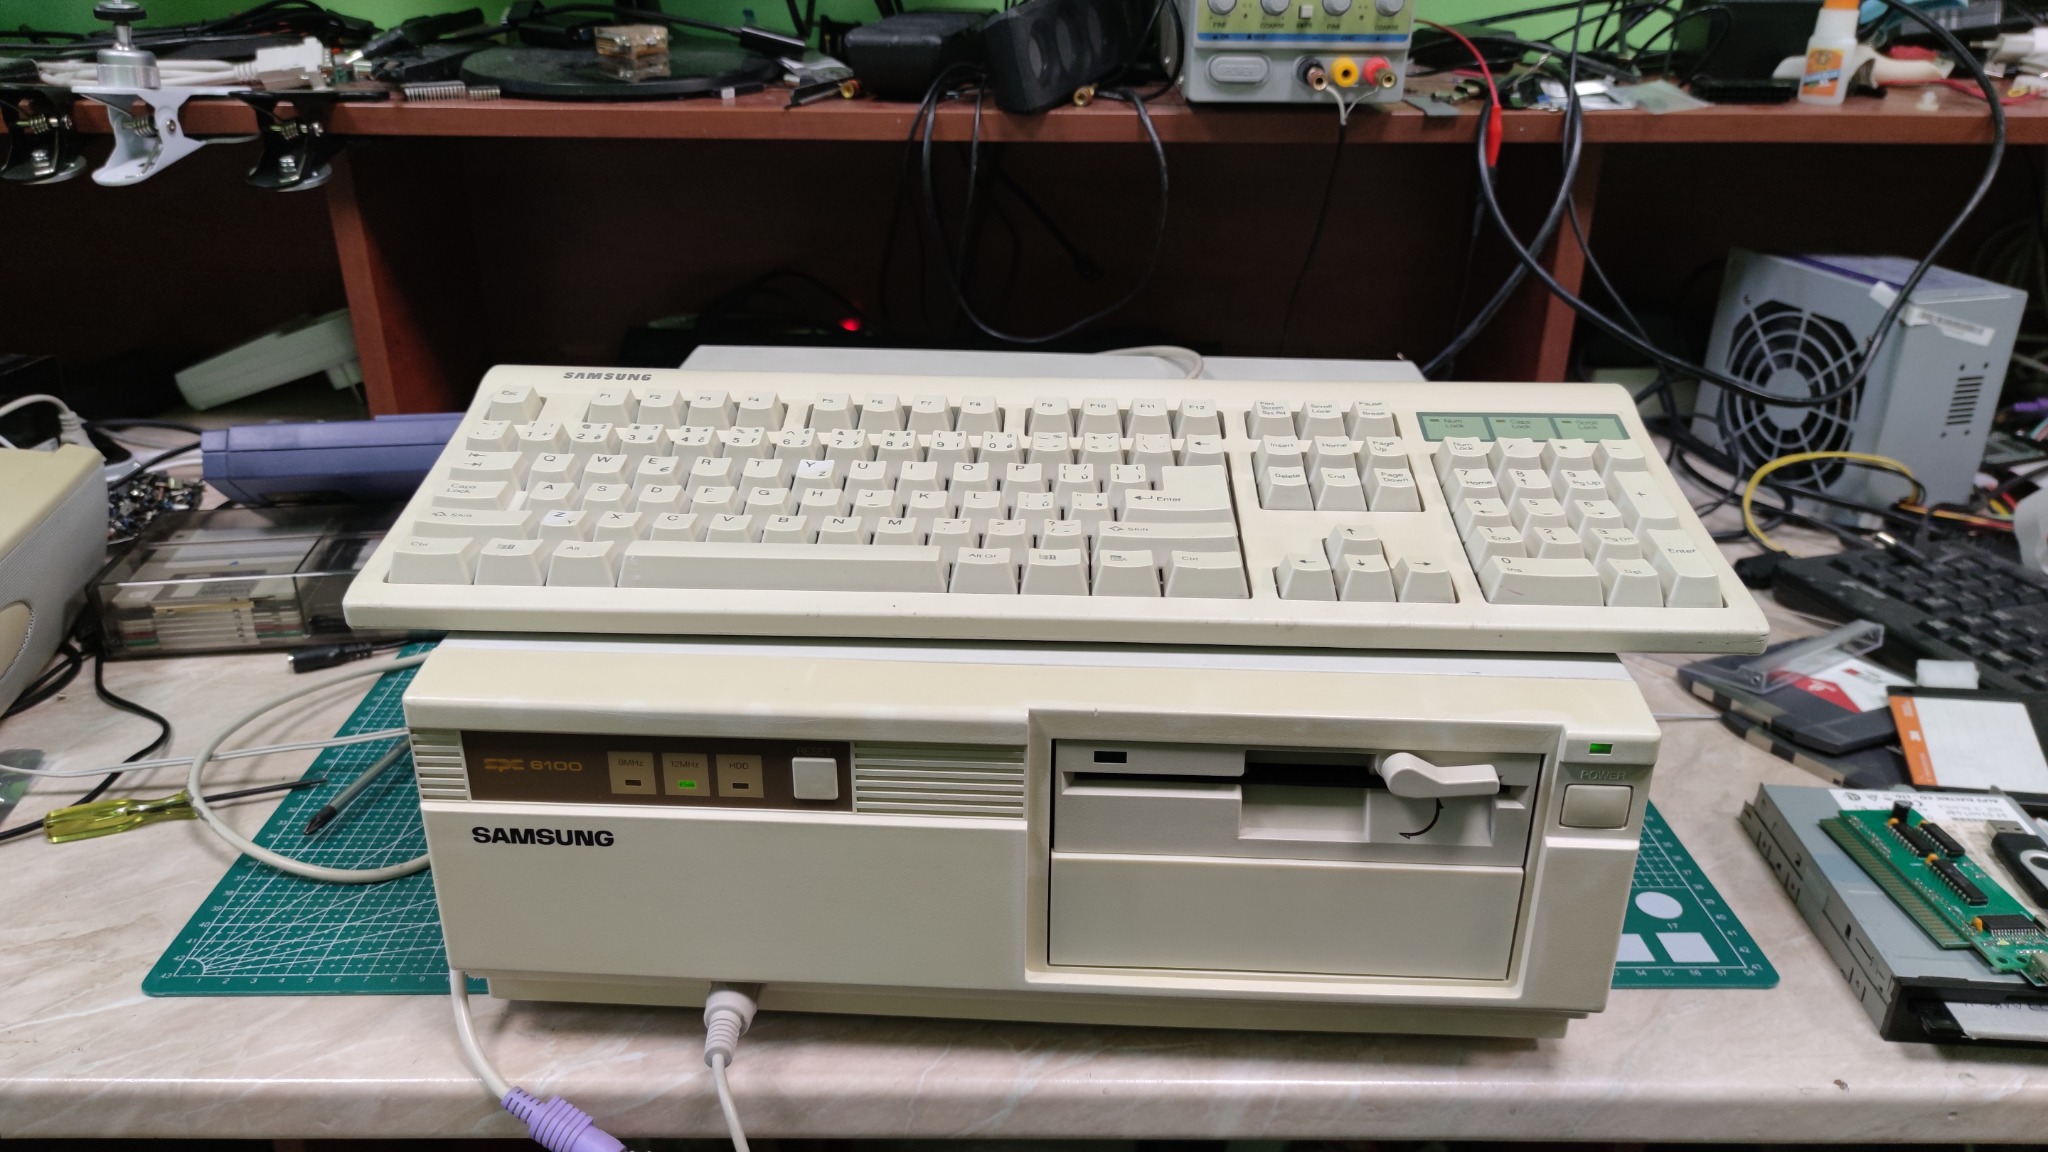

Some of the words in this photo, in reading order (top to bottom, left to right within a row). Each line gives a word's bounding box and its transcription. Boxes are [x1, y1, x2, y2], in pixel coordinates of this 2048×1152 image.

[563, 371, 652, 382] SAMSUNG
[618, 759, 644, 767] 8MHz
[671, 760, 700, 769] 12MHz
[729, 762, 749, 770] HDD
[1580, 769, 1626, 780] POWER
[471, 826, 615, 847] SAMSUNG
[1751, 963, 1763, 971] 43
